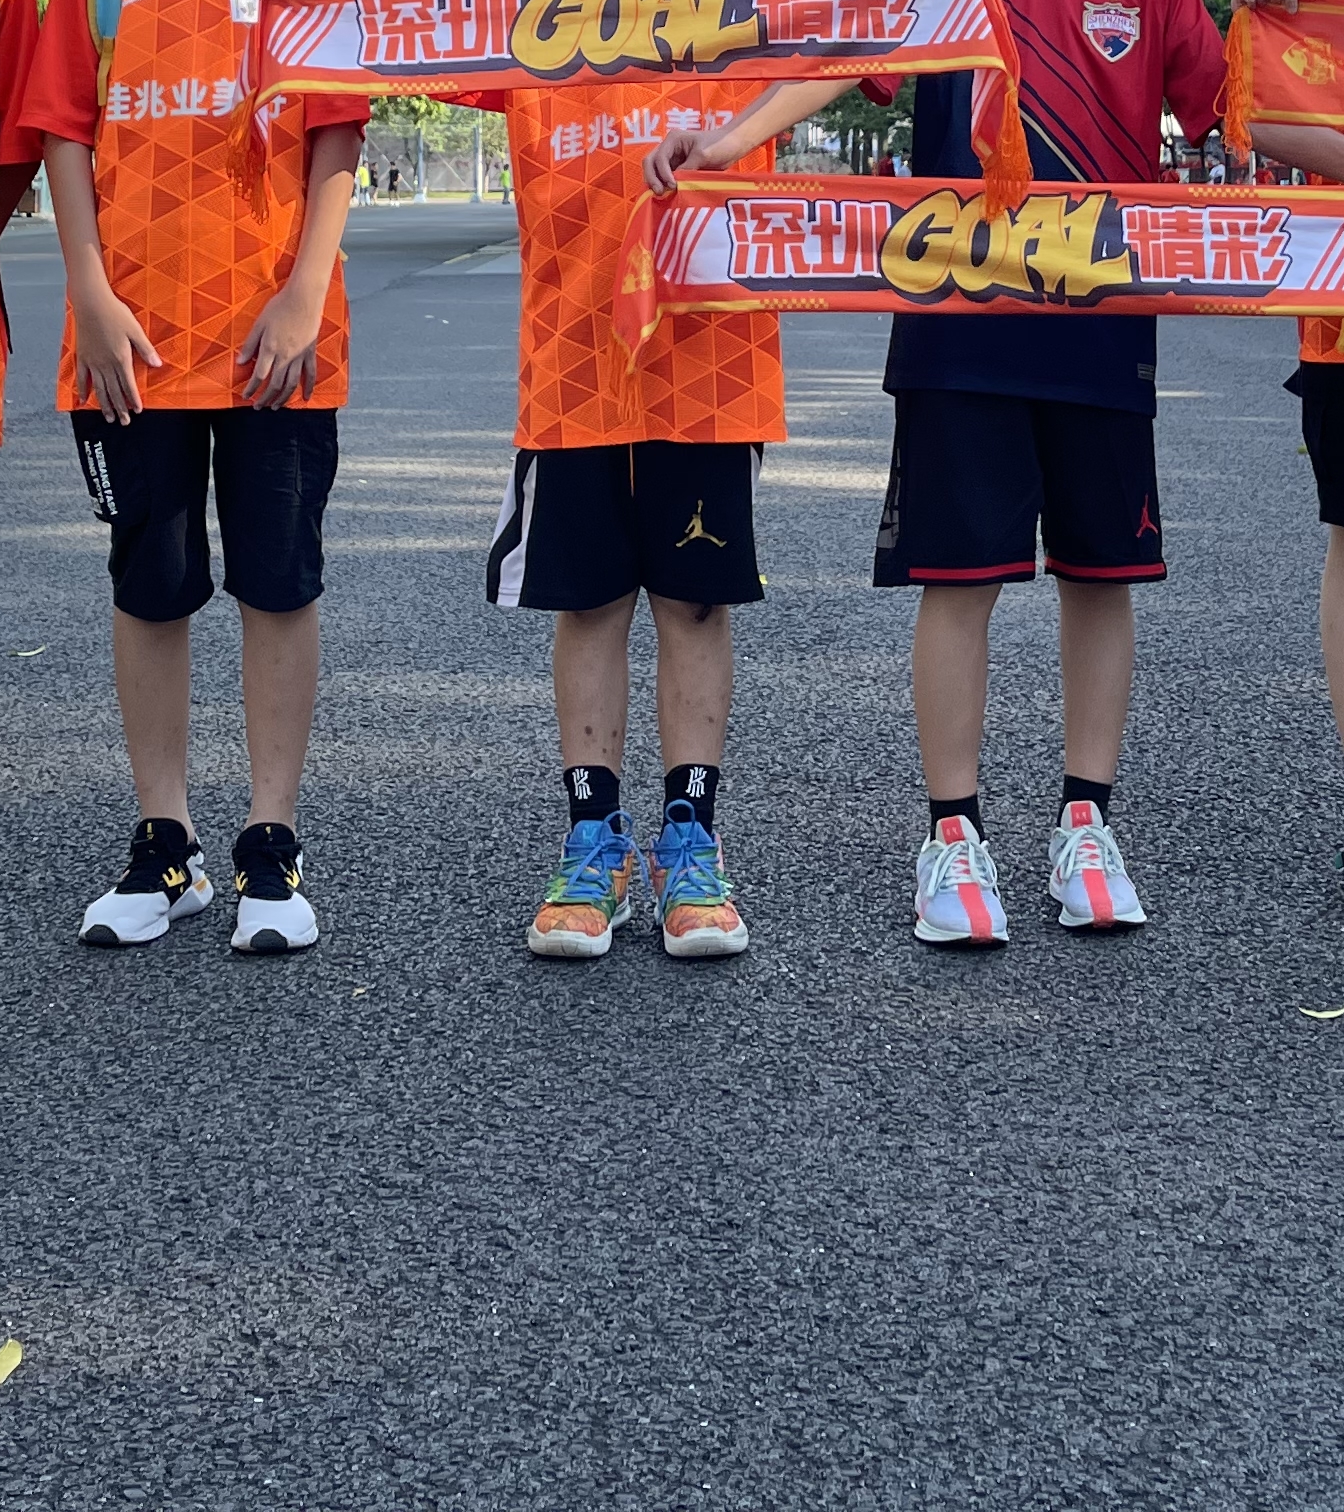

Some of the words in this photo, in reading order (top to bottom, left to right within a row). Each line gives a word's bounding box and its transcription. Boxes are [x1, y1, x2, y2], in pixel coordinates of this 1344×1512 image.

[726, 198, 892, 279] 深圳
[880, 190, 1133, 296] GOAL
[1122, 204, 1291, 284] 精彩
